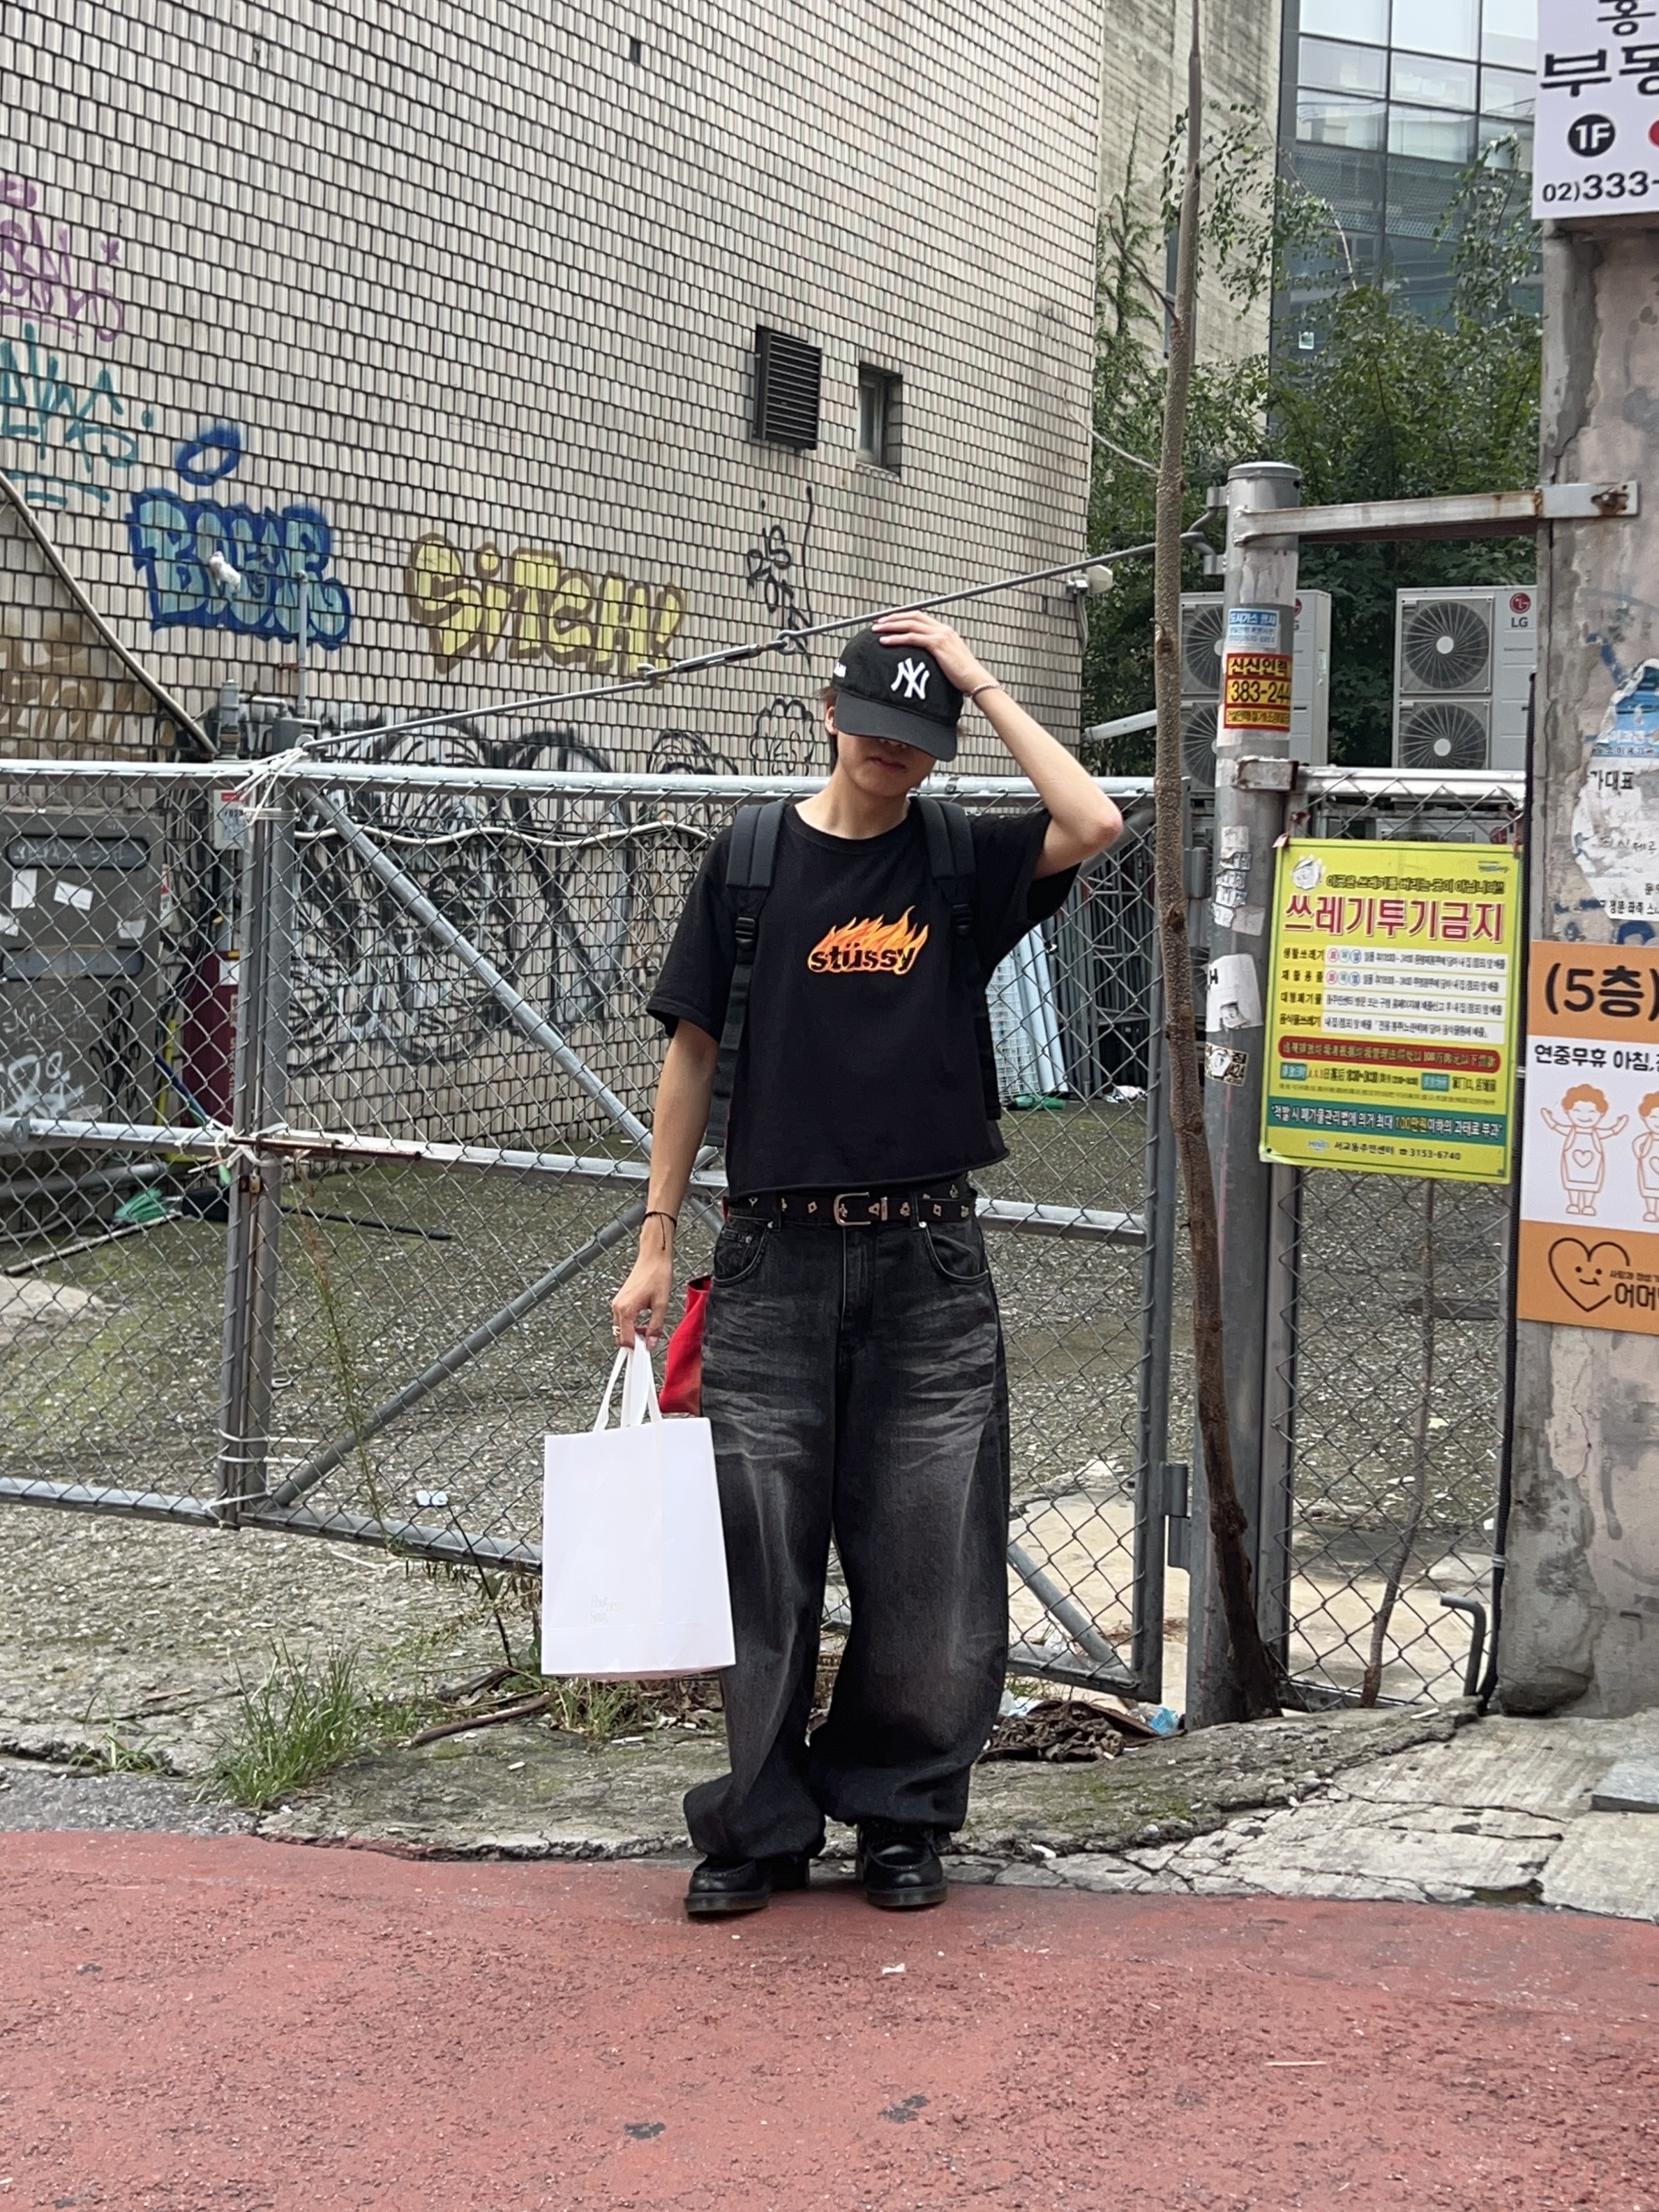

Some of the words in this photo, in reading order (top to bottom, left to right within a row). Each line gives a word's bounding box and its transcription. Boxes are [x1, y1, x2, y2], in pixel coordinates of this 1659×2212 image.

[1575, 123, 1611, 149] 1F
[1511, 617, 1529, 628] LG
[890, 657, 930, 700] NY
[1357, 876, 1397, 891] 쓰레기를
[1399, 878, 1431, 892] 버리는
[1283, 894, 1505, 943] 쓰레기투기금지
[1535, 1044, 1607, 1069] 연중무휴
[1358, 1113, 1374, 1128] 의거
[1376, 1113, 1393, 1129] 최대
[1454, 1120, 1480, 1136] 과태료
[1615, 1283, 1659, 1311] 어머
